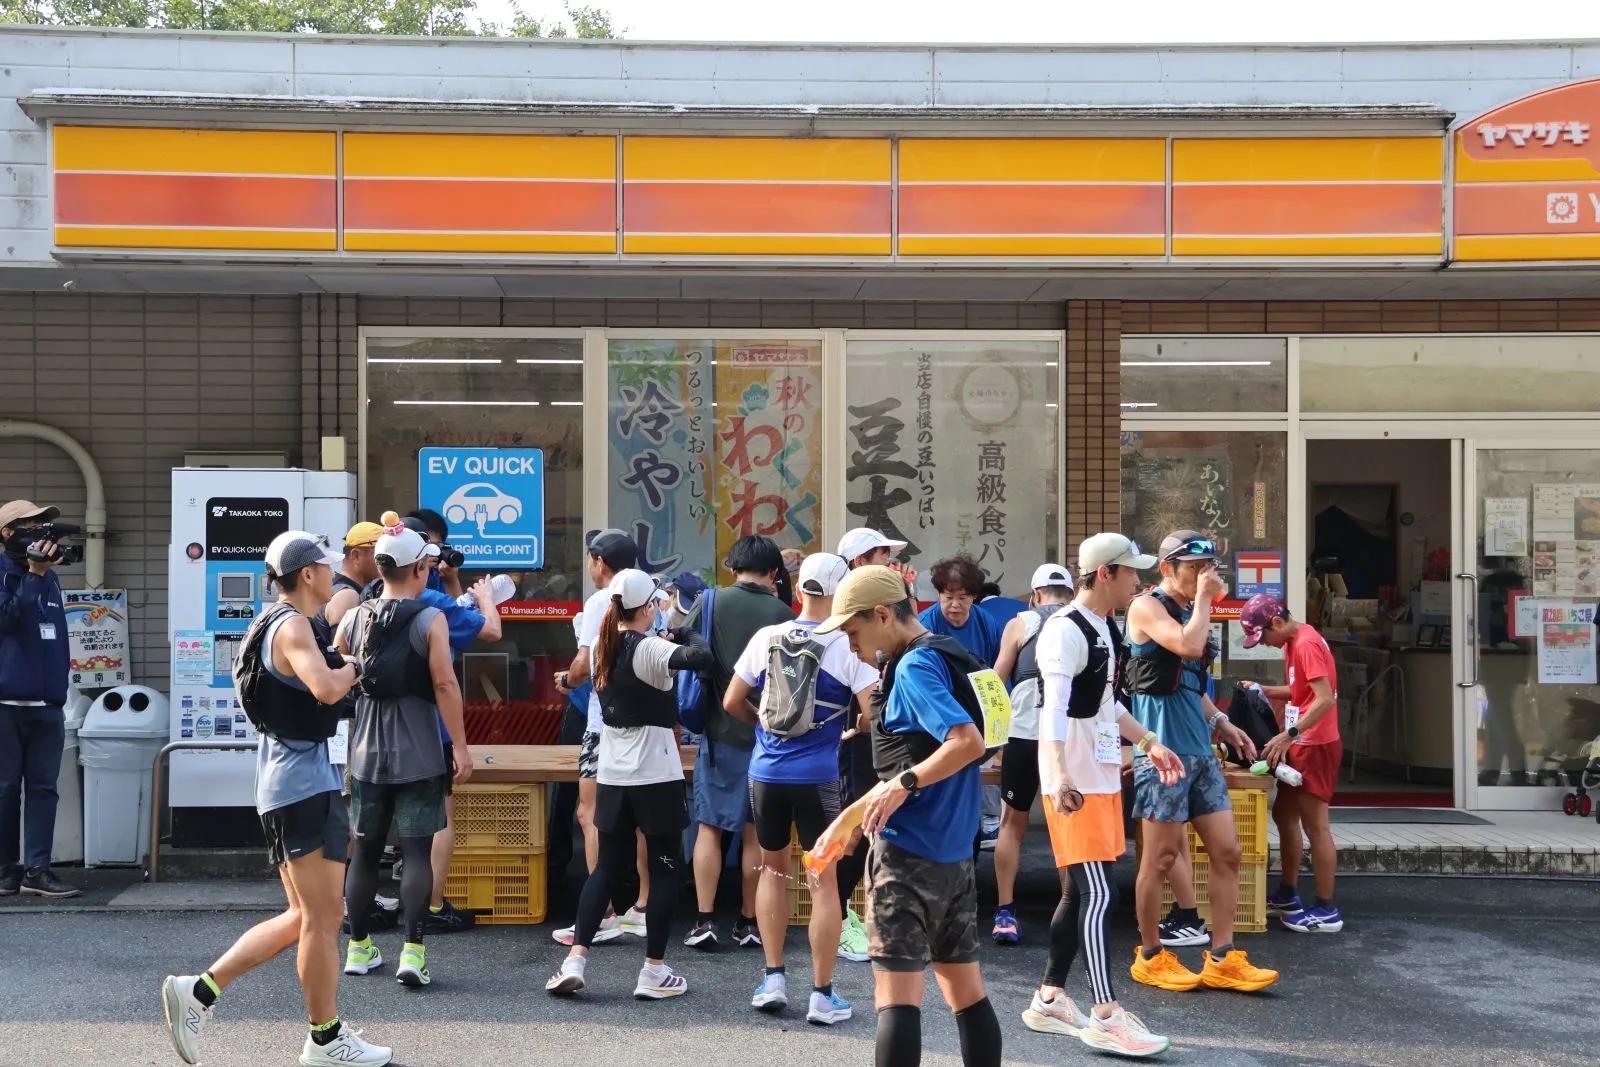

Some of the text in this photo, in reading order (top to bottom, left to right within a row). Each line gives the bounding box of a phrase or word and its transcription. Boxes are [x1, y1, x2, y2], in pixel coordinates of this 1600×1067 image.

[1477, 121, 1591, 148] ヤマザキ
[772, 375, 813, 433] 秋の
[687, 351, 706, 518] つるっとおいしい
[428, 456, 535, 476] EV QUICK
[618, 381, 683, 575] 冷やし
[846, 397, 922, 563] 豆大
[451, 544, 532, 555] RGING POINT
[91, 606, 109, 620] CAN
[509, 606, 568, 616] Yamazaki Shop
[1214, 606, 1243, 614] Yamaza
